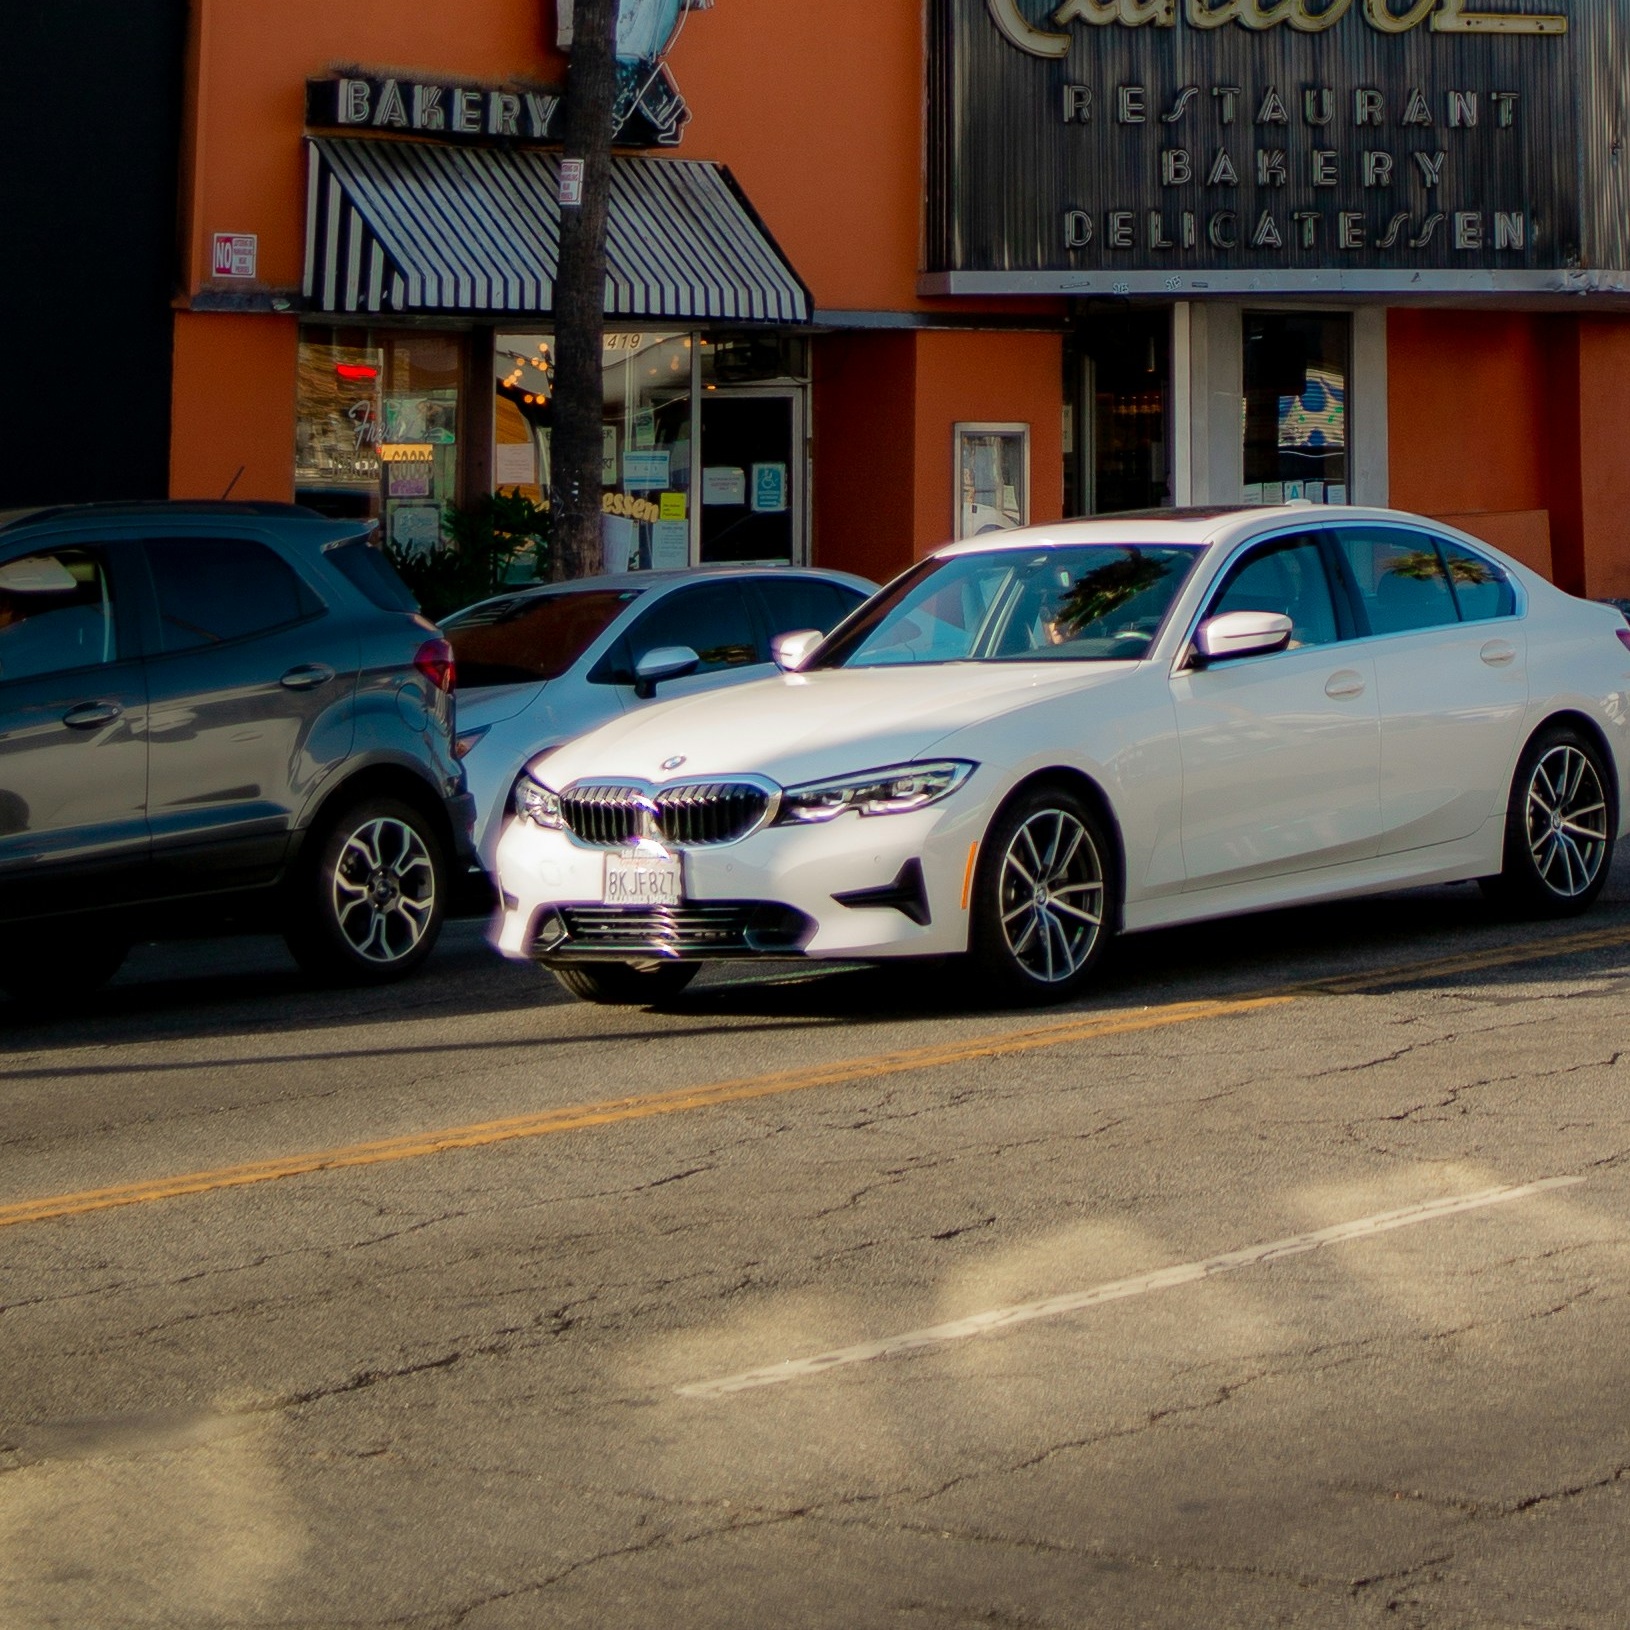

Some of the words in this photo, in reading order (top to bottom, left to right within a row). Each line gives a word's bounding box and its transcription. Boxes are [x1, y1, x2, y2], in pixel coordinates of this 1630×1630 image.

[338, 78, 560, 138] BAKERY
[1063, 83, 1521, 130] RESTAURANT
[1162, 147, 1448, 188] BAKERY
[1063, 208, 1526, 251] DELICATESSEN
[216, 242, 231, 268] NO
[607, 333, 641, 349] 419
[608, 871, 675, 896] 8KJF827
